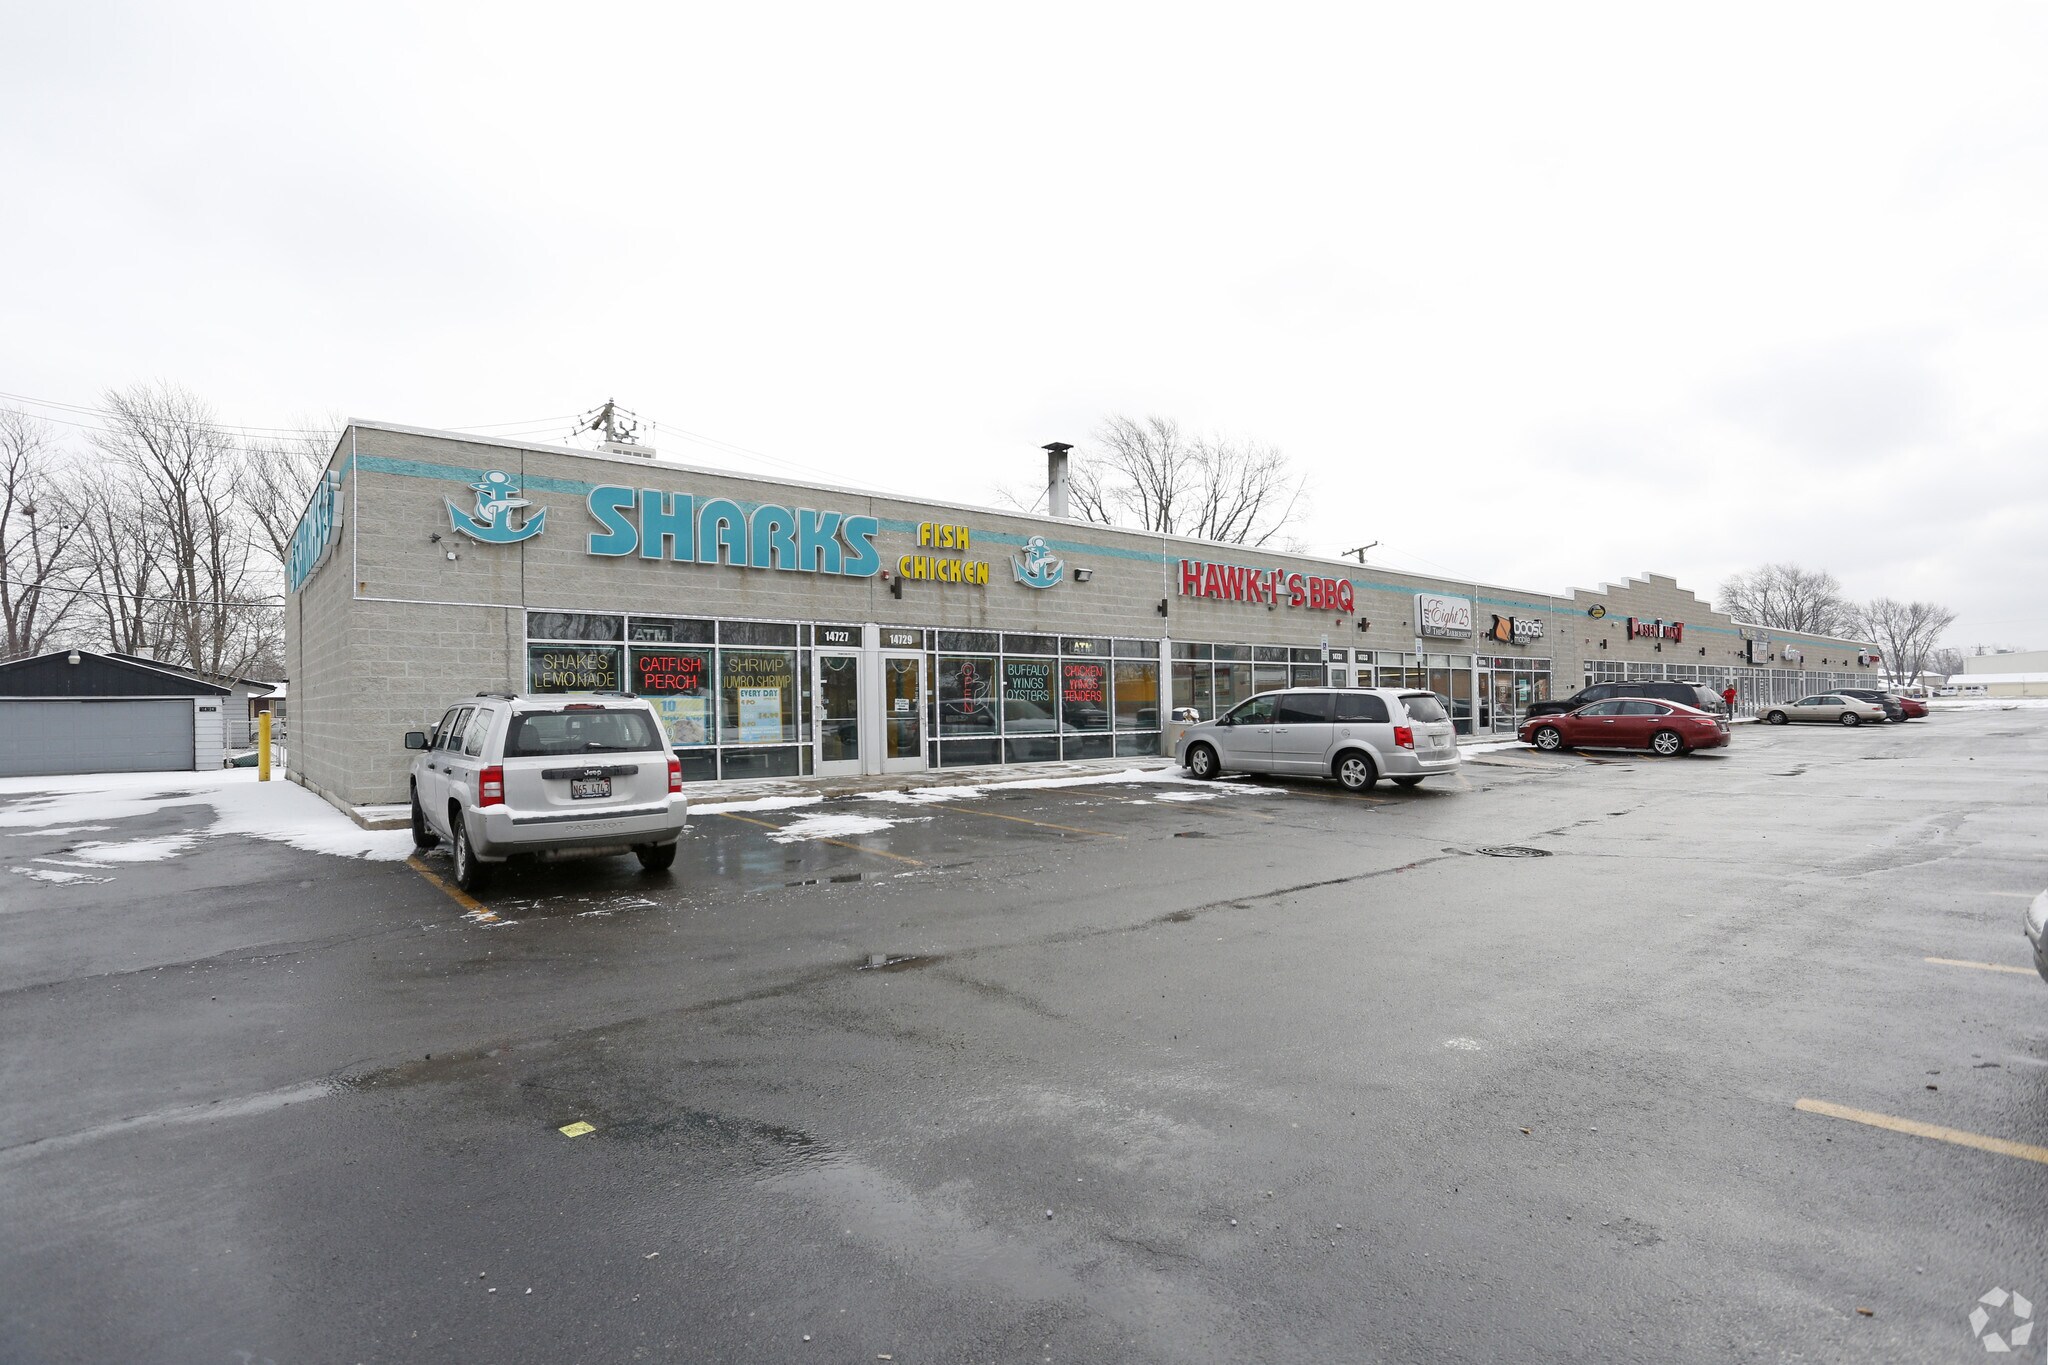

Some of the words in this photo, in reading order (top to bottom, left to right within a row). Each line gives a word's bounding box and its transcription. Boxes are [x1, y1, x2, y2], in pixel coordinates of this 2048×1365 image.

[586, 484, 881, 577] SHARKS
[917, 522, 970, 550] FISH
[896, 554, 989, 585] CHICKEN
[1306, 575, 1355, 615] BBQ
[1458, 607, 1470, 627] 23
[1513, 617, 1543, 636] boost
[633, 628, 667, 642] ATM
[825, 631, 849, 642] 14727
[889, 635, 913, 645] 14729
[542, 654, 608, 670] SHAKES
[639, 657, 701, 672] CATFISH
[729, 658, 784, 673] SHRIMP
[1007, 664, 1049, 676] BUFFALO
[1064, 665, 1103, 677] CHICKEN
[534, 671, 615, 688] LEMONADE
[645, 674, 697, 689] PERCH
[756, 675, 791, 689] SHRIMP
[1012, 677, 1044, 689] WINGS
[740, 689, 761, 697] EVERY
[963, 664, 973, 713] OPEN
[1006, 690, 1049, 701] OYSTERS
[1064, 690, 1102, 702] TENDERS
[583, 769, 602, 777] Jeep
[573, 784, 588, 796] N65
[591, 783, 610, 794] 4743
